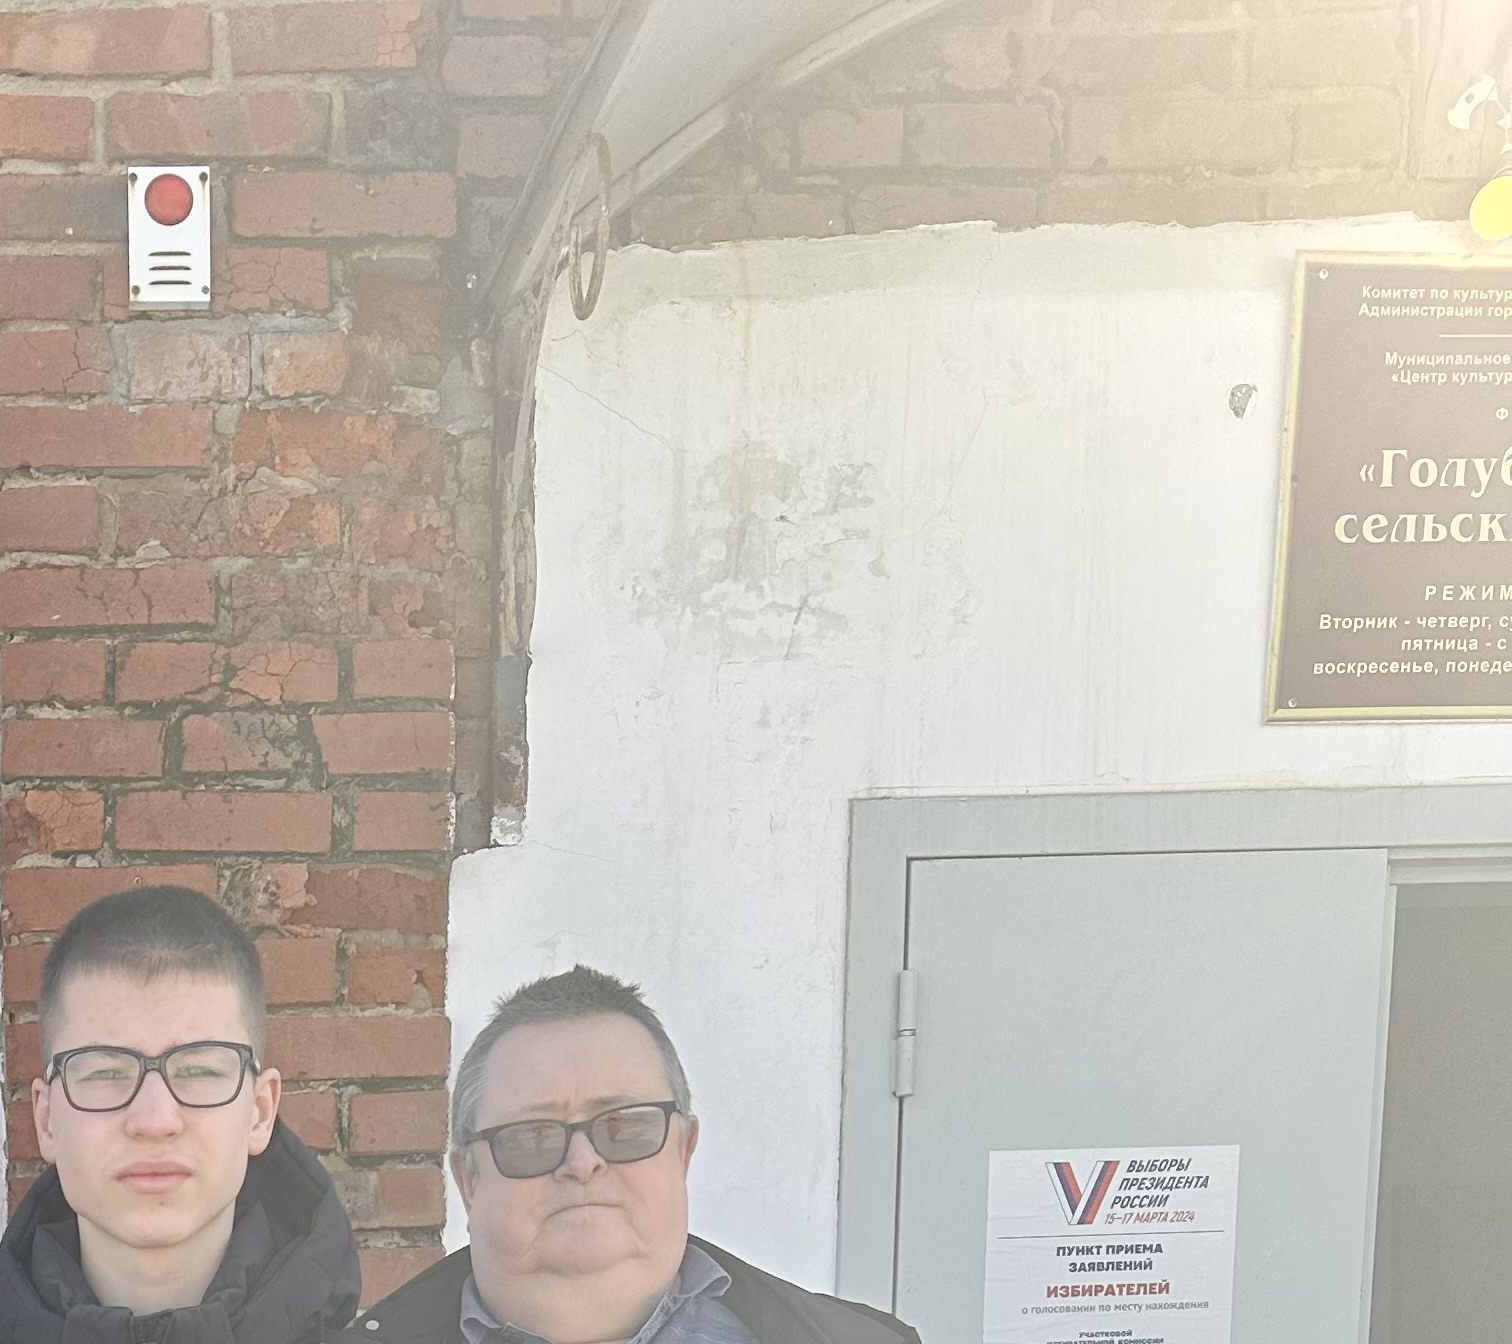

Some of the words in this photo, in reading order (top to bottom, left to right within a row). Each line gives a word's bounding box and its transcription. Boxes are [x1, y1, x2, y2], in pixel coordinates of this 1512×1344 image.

[1362, 285, 1426, 299] Комитет
[1430, 288, 1449, 299] по
[1358, 303, 1483, 319] Администрации
[1385, 352, 1510, 369] Муниципальное
[1391, 370, 1447, 386] «Центр
[1335, 513, 1512, 543] сельск
[1425, 585, 1512, 601] РЕЖИМ
[1319, 614, 1398, 632] Вторник
[1417, 616, 1492, 631] четверг,
[1401, 638, 1478, 652] пятница
[1498, 638, 1507, 650] с
[1313, 661, 1438, 677] воскресенье,
[1126, 1158, 1192, 1173] ВЫБОРЫ
[1118, 1175, 1209, 1192] ПРЕЗИДЕНТА
[1110, 1194, 1170, 1209] РОССИИ
[1133, 1211, 1169, 1224] МАРТА
[1169, 1211, 1195, 1223] 2024
[1056, 1245, 1103, 1257] ПУНКТ
[1106, 1243, 1164, 1255] ПРИЕМА
[1068, 1257, 1153, 1273] ЗАЯВЛЕНИЙ
[1046, 1279, 1170, 1299] ИЗБИРАТЕЛЕЙ
[1031, 1304, 1096, 1314] голосовании
[1098, 1304, 1111, 1312] по
[1114, 1302, 1142, 1313] месту
[1146, 1301, 1209, 1311] нахождения
